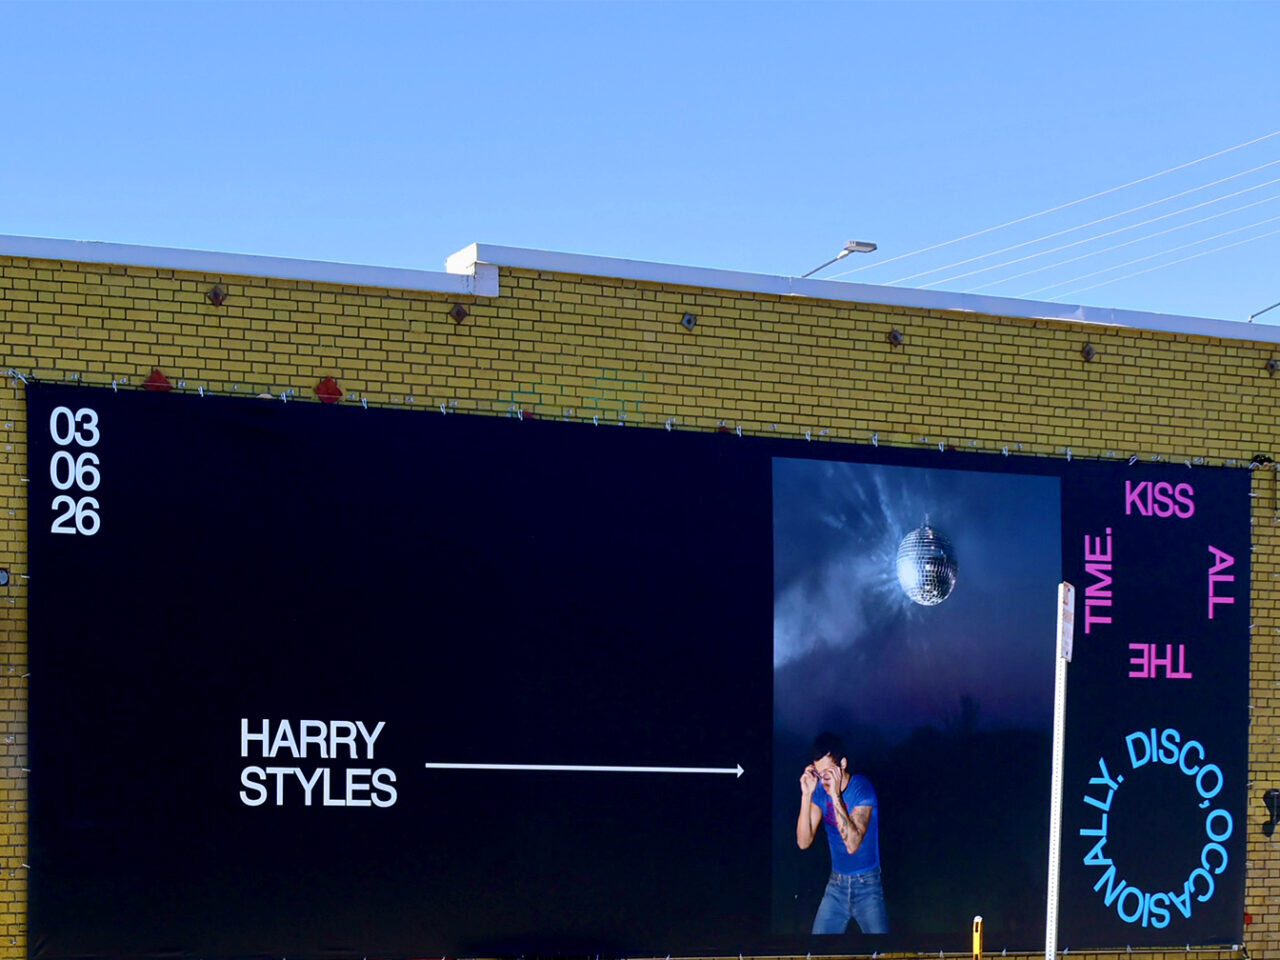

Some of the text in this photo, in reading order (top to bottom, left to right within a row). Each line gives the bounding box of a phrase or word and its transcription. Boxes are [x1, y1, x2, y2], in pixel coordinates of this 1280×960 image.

[49, 405, 101, 447] 03
[49, 450, 101, 491] 06
[50, 494, 101, 536] 26
[1125, 480, 1195, 519] KISS
[1084, 527, 1113, 634] TIME.
[1208, 545, 1235, 619] ALL
[1128, 643, 1193, 679] THE
[240, 718, 386, 760] HARRY
[239, 765, 398, 808] STYLES
[1079, 728, 1234, 929] DISCO, OCCASIONALLY.
